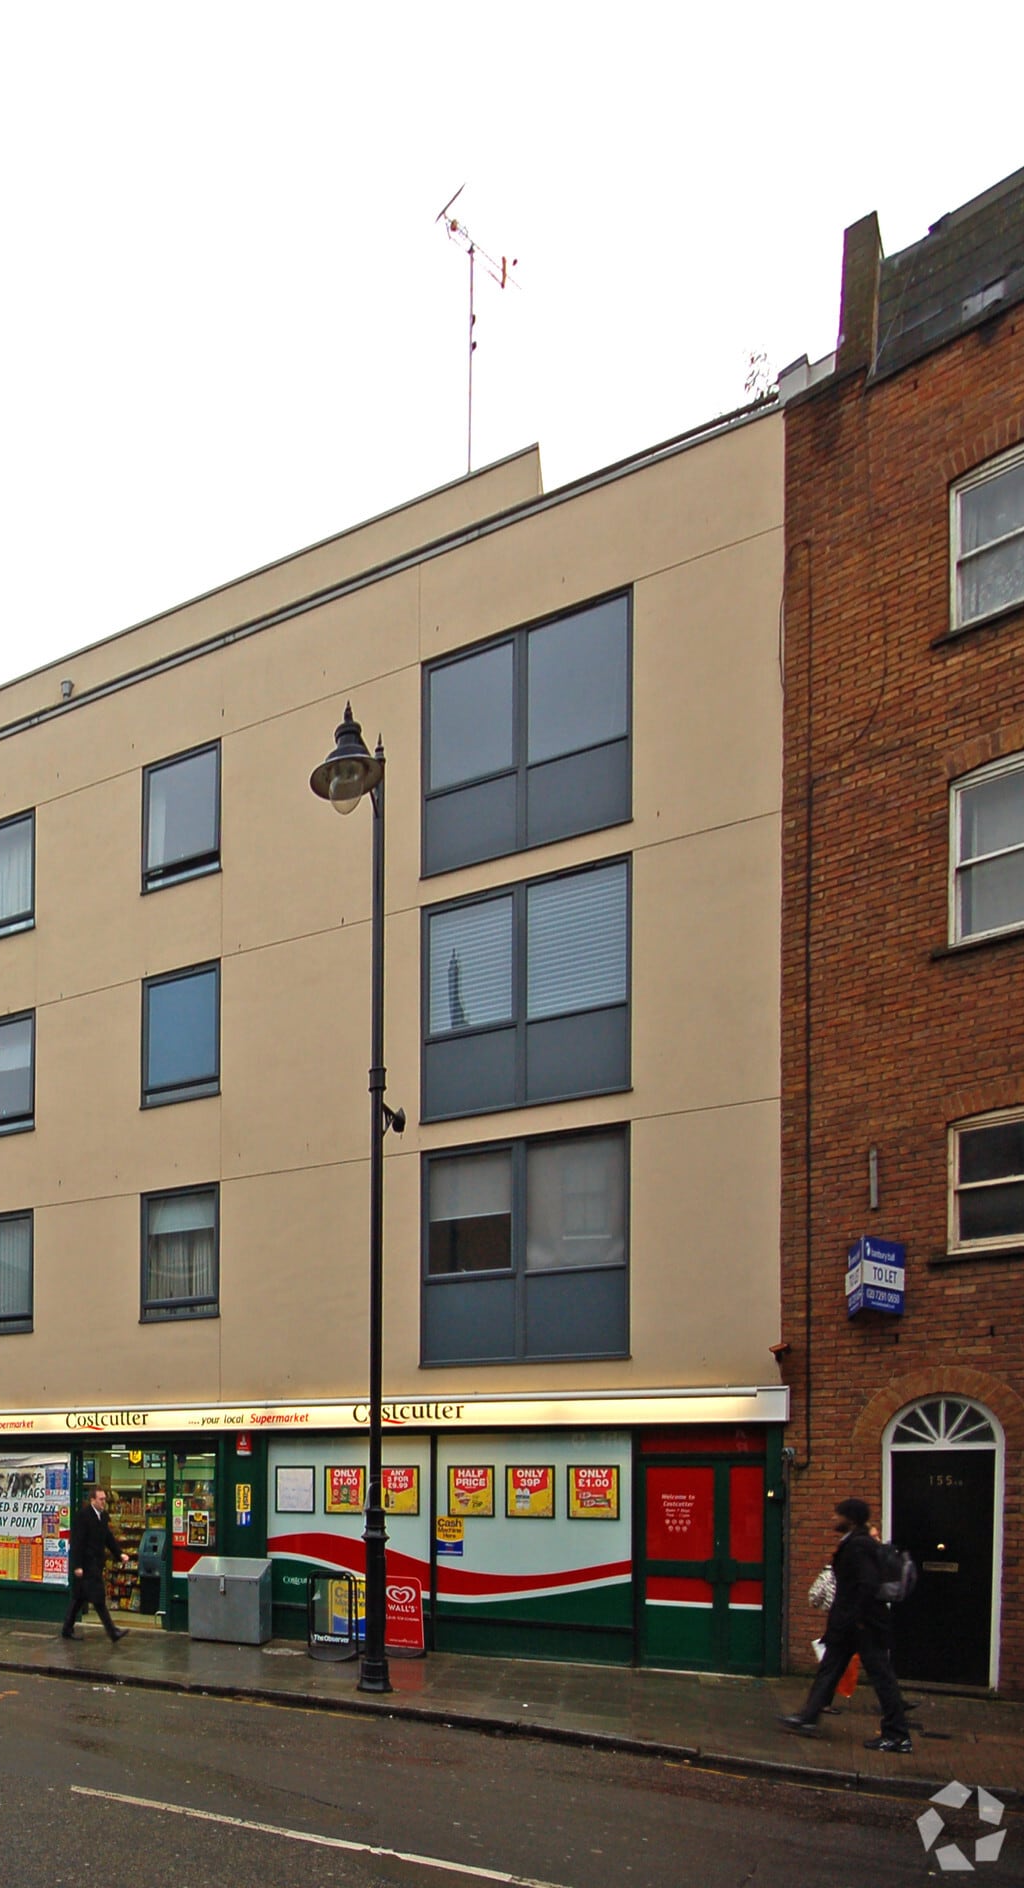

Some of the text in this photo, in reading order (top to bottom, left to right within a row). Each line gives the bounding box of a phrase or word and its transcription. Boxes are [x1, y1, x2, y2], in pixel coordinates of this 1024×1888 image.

[873, 1267, 898, 1284] TO LET
[353, 1404, 464, 1422] Cstcutter
[65, 1411, 149, 1429] Costcutter
[224, 1414, 244, 1424] local
[250, 1413, 309, 1425] Supermarket
[334, 1469, 357, 1478] ONLY
[458, 1469, 484, 1478] HALF
[516, 1469, 545, 1478] ONLY
[579, 1469, 608, 1478] ONLY
[333, 1478, 358, 1486] £1.00
[393, 1475, 409, 1483] FOR
[456, 1478, 485, 1487] PRICE
[520, 1478, 541, 1487] 39P
[578, 1478, 609, 1487] £1.00
[21, 1487, 45, 1499] MAGS
[12, 1502, 19, 1512] &
[22, 1502, 56, 1513] FROZEN
[10, 1517, 38, 1528] POINT
[438, 1518, 462, 1527] Cash
[388, 1604, 416, 1613] WALL'S
